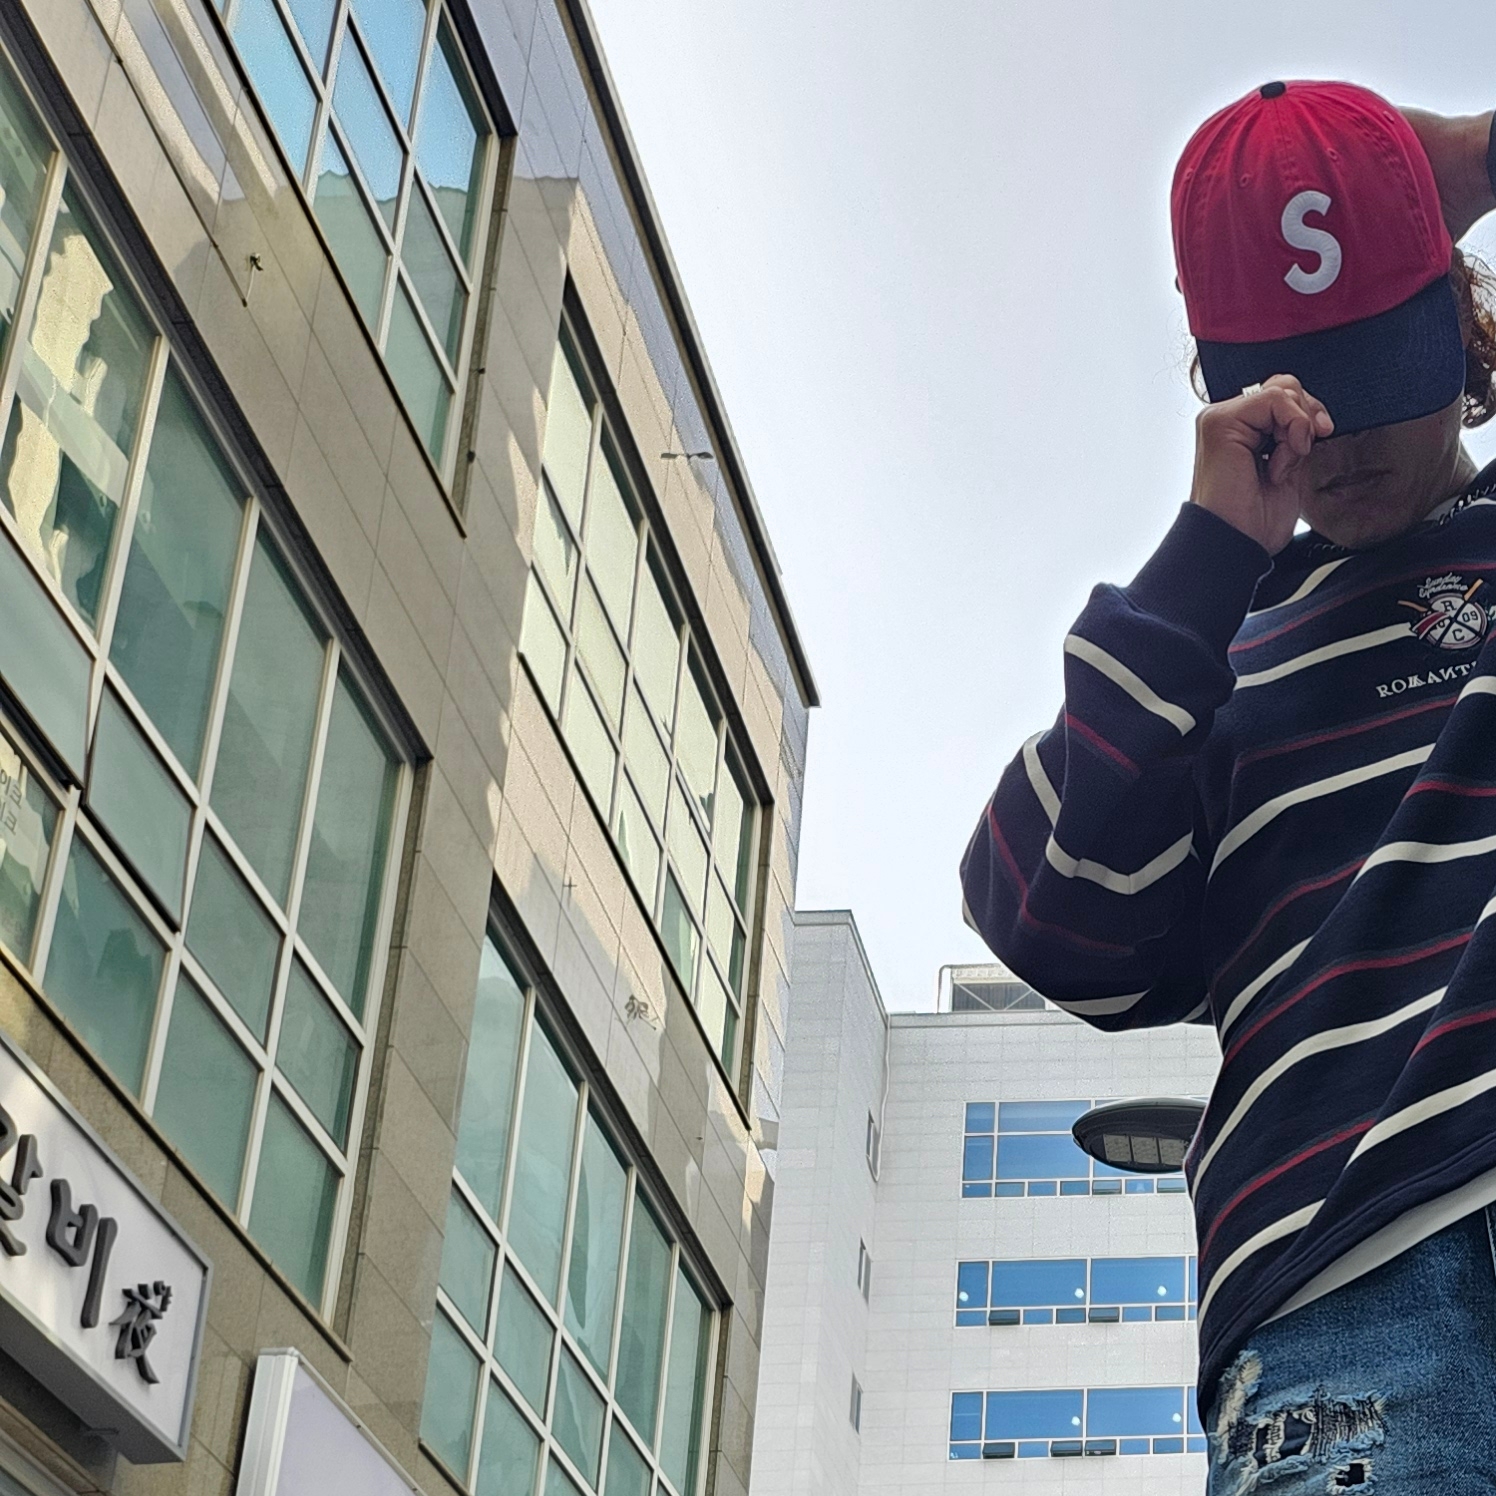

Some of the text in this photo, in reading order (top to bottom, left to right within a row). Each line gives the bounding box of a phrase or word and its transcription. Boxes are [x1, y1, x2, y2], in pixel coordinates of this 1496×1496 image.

[1281, 189, 1343, 296] S
[1461, 610, 1479, 623] 09
[1451, 628, 1466, 642] C
